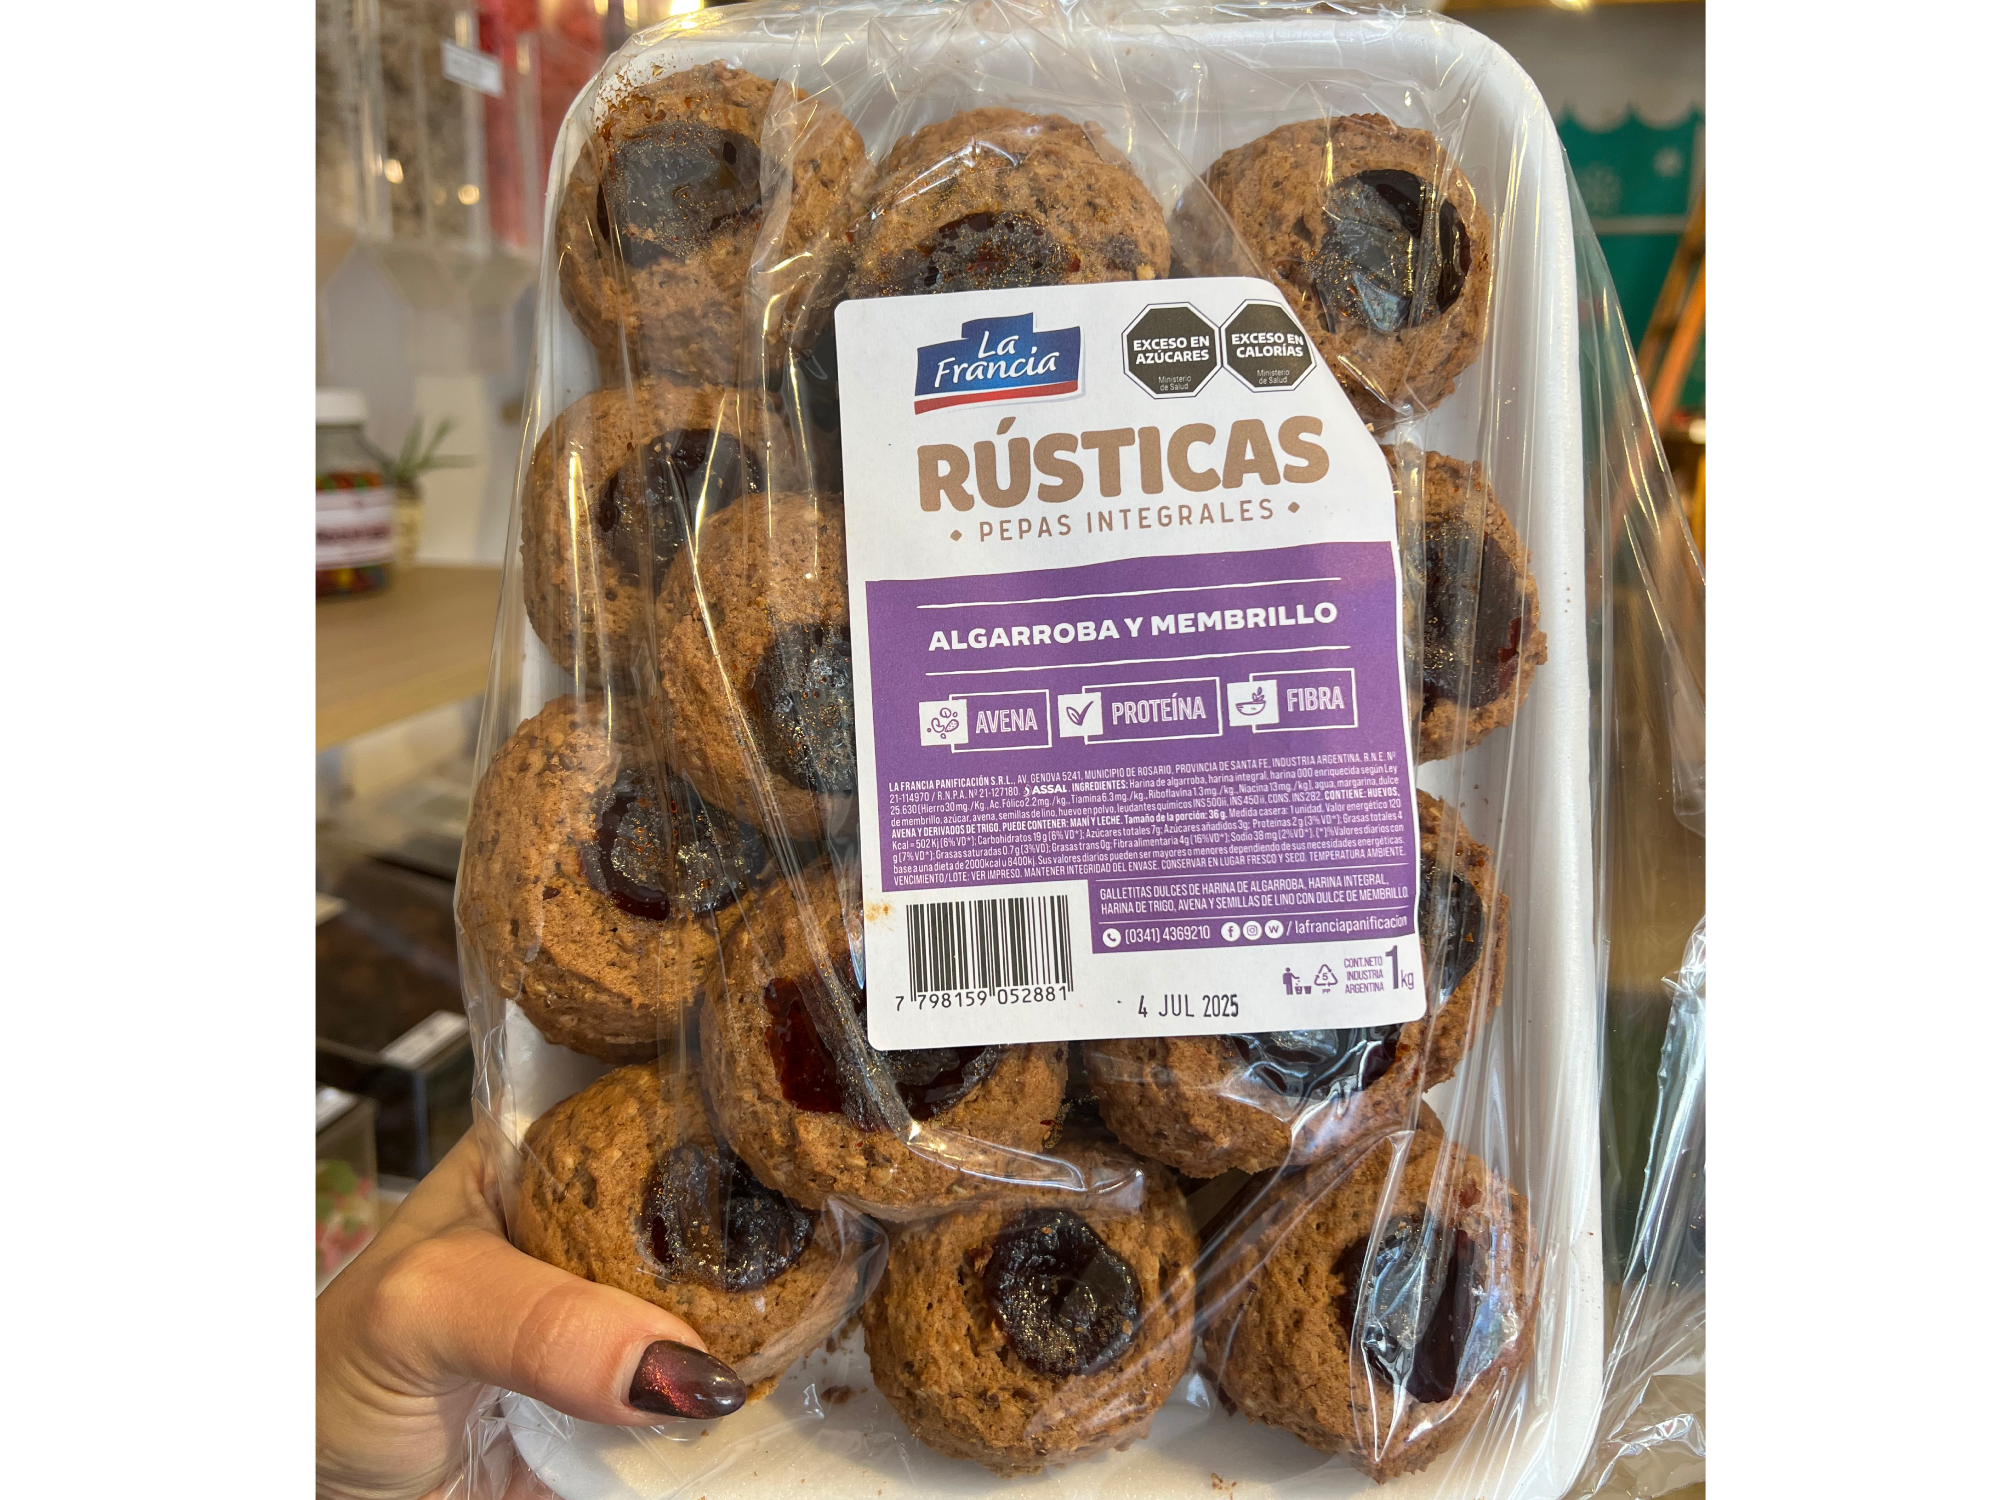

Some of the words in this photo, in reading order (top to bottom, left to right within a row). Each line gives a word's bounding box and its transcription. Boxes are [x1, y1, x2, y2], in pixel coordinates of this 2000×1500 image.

[978, 330, 1020, 360] La
[1133, 337, 1187, 351] EXCESO
[1190, 335, 1210, 348] EN
[1231, 332, 1285, 345] EXCESO
[1287, 333, 1304, 346] EN
[1236, 343, 1304, 358] CALORÍAS
[934, 345, 1060, 388] Francia
[1135, 348, 1210, 365] AZÚCARES
[1158, 375, 1192, 384] Ministerio
[1257, 368, 1290, 377] Ministerio
[1268, 376, 1288, 384] Salud
[1170, 382, 1189, 391] Salud
[917, 415, 1330, 512] RÚSTICAS
[979, 514, 1072, 542] PEPAS
[1087, 498, 1273, 533] INTEGRALES
[928, 619, 1120, 652] ALGARROBA
[1123, 616, 1145, 637] Y
[1151, 601, 1339, 636] MEMBRILLO
[1112, 692, 1206, 726] PROTEÍNA
[1287, 686, 1345, 712] FIBRA
[975, 707, 1038, 734] AVENA
[889, 782, 899, 791] LA
[900, 780, 934, 790] FRANCIA
[935, 776, 989, 788] PANIFICACIÓN
[1030, 772, 1060, 782] GENOVA
[1084, 768, 1124, 779] MUNICIPIO
[1126, 767, 1135, 776] DE
[1175, 762, 1217, 773] PROVINCIA
[1218, 761, 1229, 770] DE
[1230, 759, 1257, 769] SANTA
[1272, 756, 1315, 767] INDUSTRIA
[889, 791, 929, 803] 21-114970
[937, 789, 966, 800] R.N.P.A.
[1071, 779, 1128, 791] INGREDIENTES:
[1129, 778, 1154, 788] Harina
[1155, 777, 1165, 786] de
[1208, 773, 1233, 783] harina
[1270, 769, 1296, 779] harina
[1296, 768, 1313, 777] 000
[1314, 765, 1360, 777] enriquecida
[1360, 764, 1384, 775] según
[1383, 763, 1397, 774] Ley
[891, 828, 916, 838] AVENA
[923, 824, 964, 836] DERIVADOS
[965, 824, 975, 833] DE
[976, 822, 1000, 832] TRIGO.
[1002, 821, 1026, 831] PUEDE
[1027, 818, 1068, 829] CONTENER:
[1069, 816, 1089, 826] MANÍ
[1096, 815, 1122, 825] LECHE.
[1124, 813, 1154, 823] Tamaño
[1155, 812, 1165, 821] de
[1166, 812, 1174, 821] la
[1175, 810, 1207, 822] porción:
[1208, 809, 1219, 818] 36
[1228, 807, 1257, 817] Medida
[1294, 804, 1323, 813] unidad.
[1325, 802, 1345, 811] Valor
[1346, 801, 1388, 812] energético
[1388, 798, 1401, 808] 120
[893, 864, 912, 873] base
[918, 864, 933, 872] una
[933, 861, 953, 871] dieta
[954, 861, 964, 869] de
[1037, 854, 1051, 864] Sus
[1052, 853, 1081, 863] valores
[1082, 852, 1108, 861] diarios
[1109, 850, 1137, 861] pueden
[1152, 849, 1186, 859] mayores
[1193, 846, 1228, 855] menores
[1228, 842, 1280, 854] dependiendo
[1280, 841, 1291, 850] de
[1291, 842, 1305, 850] sus
[1306, 837, 1356, 849] necesidades
[893, 871, 969, 885] VENCIMIENTO/LOTE:
[971, 870, 985, 880] VER
[987, 868, 1021, 879] IMPRESO.
[1024, 865, 1065, 877] MANTENER
[1066, 863, 1110, 874] INTEGRIDAD
[1112, 862, 1126, 871] DEL
[1128, 860, 1157, 871] ENVASE.
[1161, 857, 1206, 869] CONSERVAR
[1207, 857, 1218, 866] EN
[1219, 855, 1245, 865] LUGAR
[1246, 853, 1276, 864] FRESCO
[1309, 848, 1365, 861] TEMPERATURA
[1366, 846, 1405, 857] AMBIENTE.
[1100, 886, 1152, 900] GALLETITAS
[1154, 884, 1187, 898] DULCES
[1189, 883, 1200, 896] DE
[1202, 882, 1236, 895] HARINA
[1237, 881, 1248, 893] DE
[1308, 876, 1342, 889] HARINA
[1101, 902, 1134, 915] HARINA
[1136, 901, 1147, 913] DE
[1178, 898, 1207, 911] AVENA
[1208, 898, 1215, 909] Y
[1216, 895, 1260, 909] SEMILLAS
[1261, 894, 1273, 907] DE
[1274, 893, 1295, 906] LINO
[1296, 892, 1315, 904] CON
[1316, 890, 1345, 903] DULCE
[1346, 889, 1358, 902] DE
[1125, 927, 1161, 945] (0341)
[1162, 925, 1211, 940] 4369210
[1322, 972, 1328, 981] 5
[1347, 969, 1384, 981] INDUSTRIA
[1385, 945, 1399, 990] 1
[1401, 969, 1414, 990] kg
[895, 995, 904, 1011] 7
[917, 992, 987, 1010] 798159
[998, 986, 1068, 1005] 052881
[1345, 982, 1384, 994] ARGENTINA
[1138, 995, 1148, 1018] 4
[1159, 994, 1194, 1018] JUL
[1202, 993, 1240, 1018] 2025
